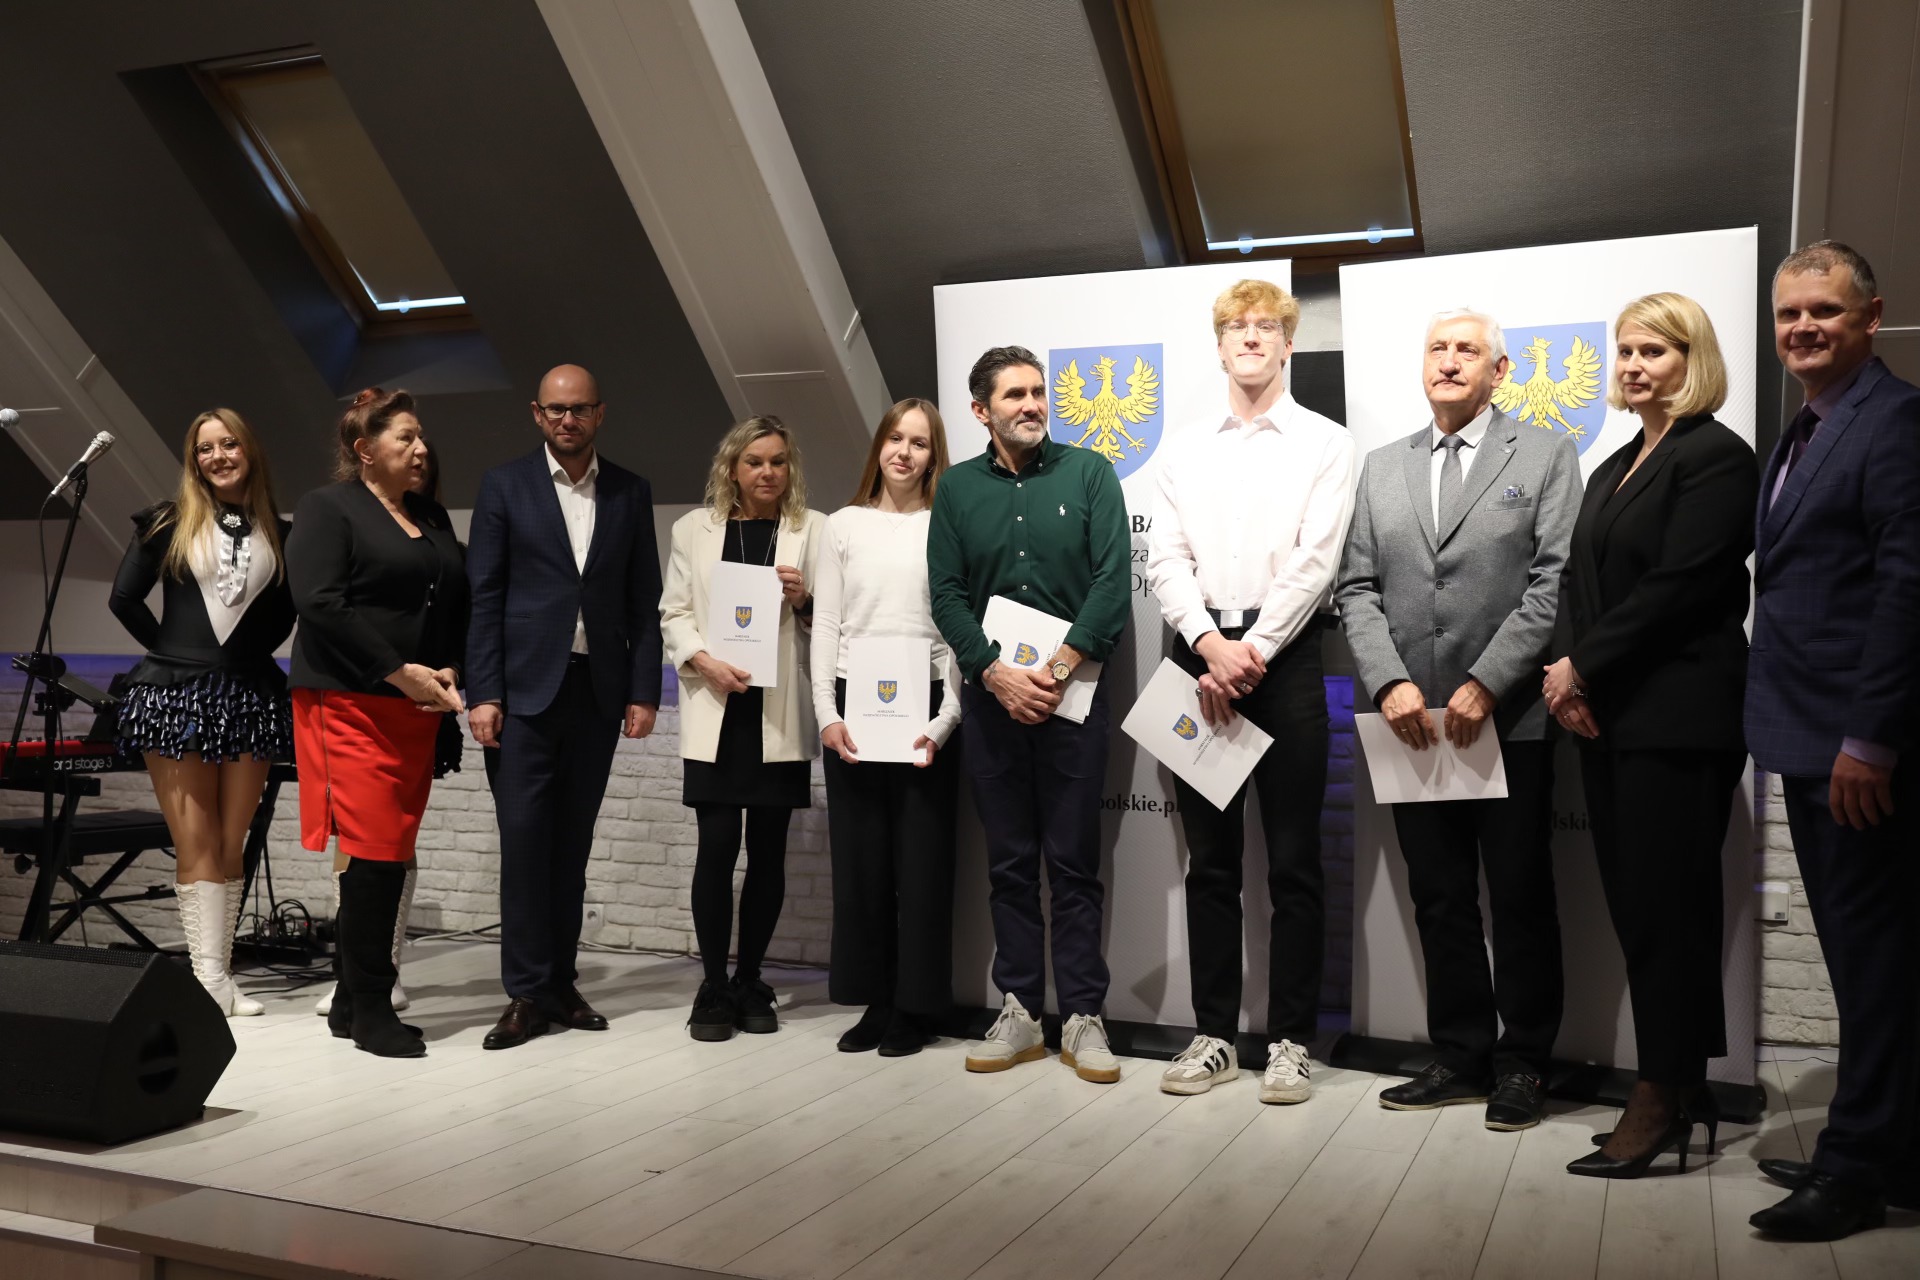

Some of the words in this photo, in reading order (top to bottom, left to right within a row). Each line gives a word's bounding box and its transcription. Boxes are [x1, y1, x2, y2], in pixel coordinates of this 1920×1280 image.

[74, 757, 105, 771] stage
[106, 756, 113, 768] 3
[1552, 809, 1590, 831] lski
